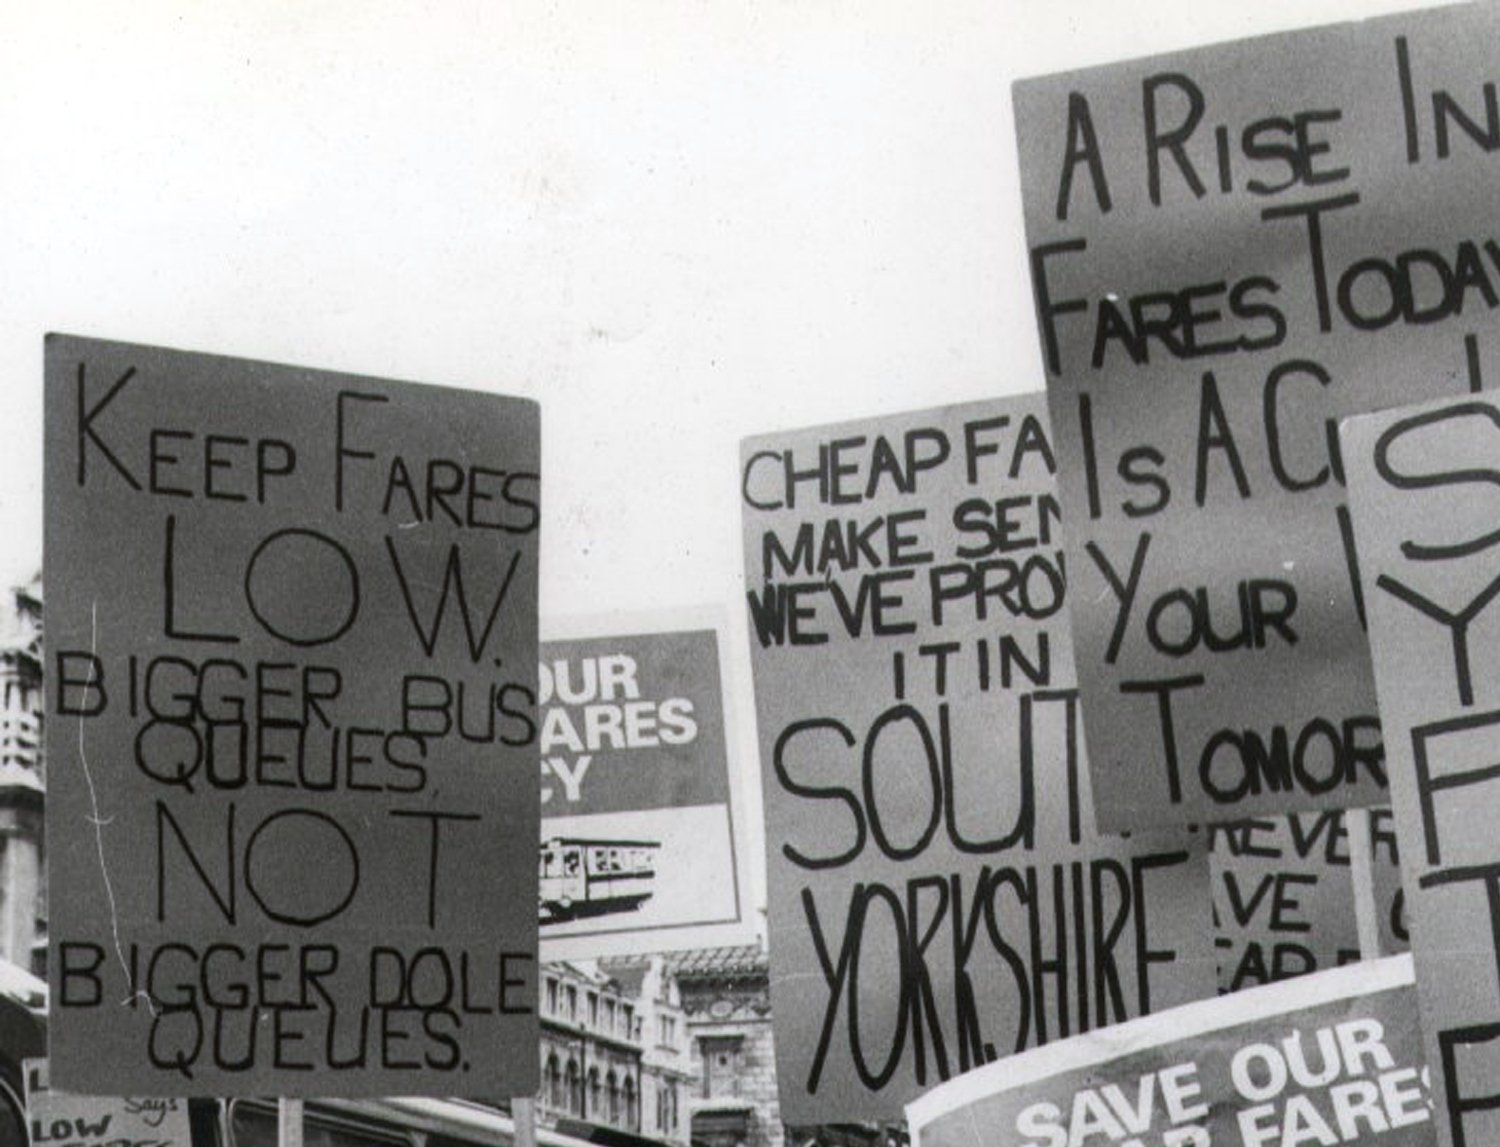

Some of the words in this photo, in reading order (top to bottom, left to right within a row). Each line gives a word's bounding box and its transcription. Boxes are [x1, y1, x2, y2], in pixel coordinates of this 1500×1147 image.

[1056, 92, 1112, 221] A
[1031, 239, 1288, 377] FARES
[76, 361, 297, 505] KEEP
[334, 390, 541, 535] FARES
[741, 428, 951, 511] CHEAP
[1195, 370, 1252, 508] A
[162, 513, 523, 664] LOW.
[762, 510, 934, 584] MAKE
[952, 494, 1062, 559] SEN
[1084, 531, 1299, 665] YOUR
[55, 650, 343, 729] BIGGER
[401, 674, 538, 747] BUS
[540, 697, 698, 754] ARES
[894, 641, 961, 700] IT
[978, 631, 1050, 692] IN
[773, 688, 1079, 870] SOUT
[1119, 674, 1389, 804] TOMOR
[155, 800, 482, 929] NOT
[58, 941, 343, 1011] BIGGER
[370, 946, 535, 1016] DOLE
[802, 851, 1190, 1095] YORKSHIRE
[147, 1003, 471, 1080] QUEUES.
[1229, 1017, 1396, 1102] OUR
[29, 1114, 113, 1143] LOW
